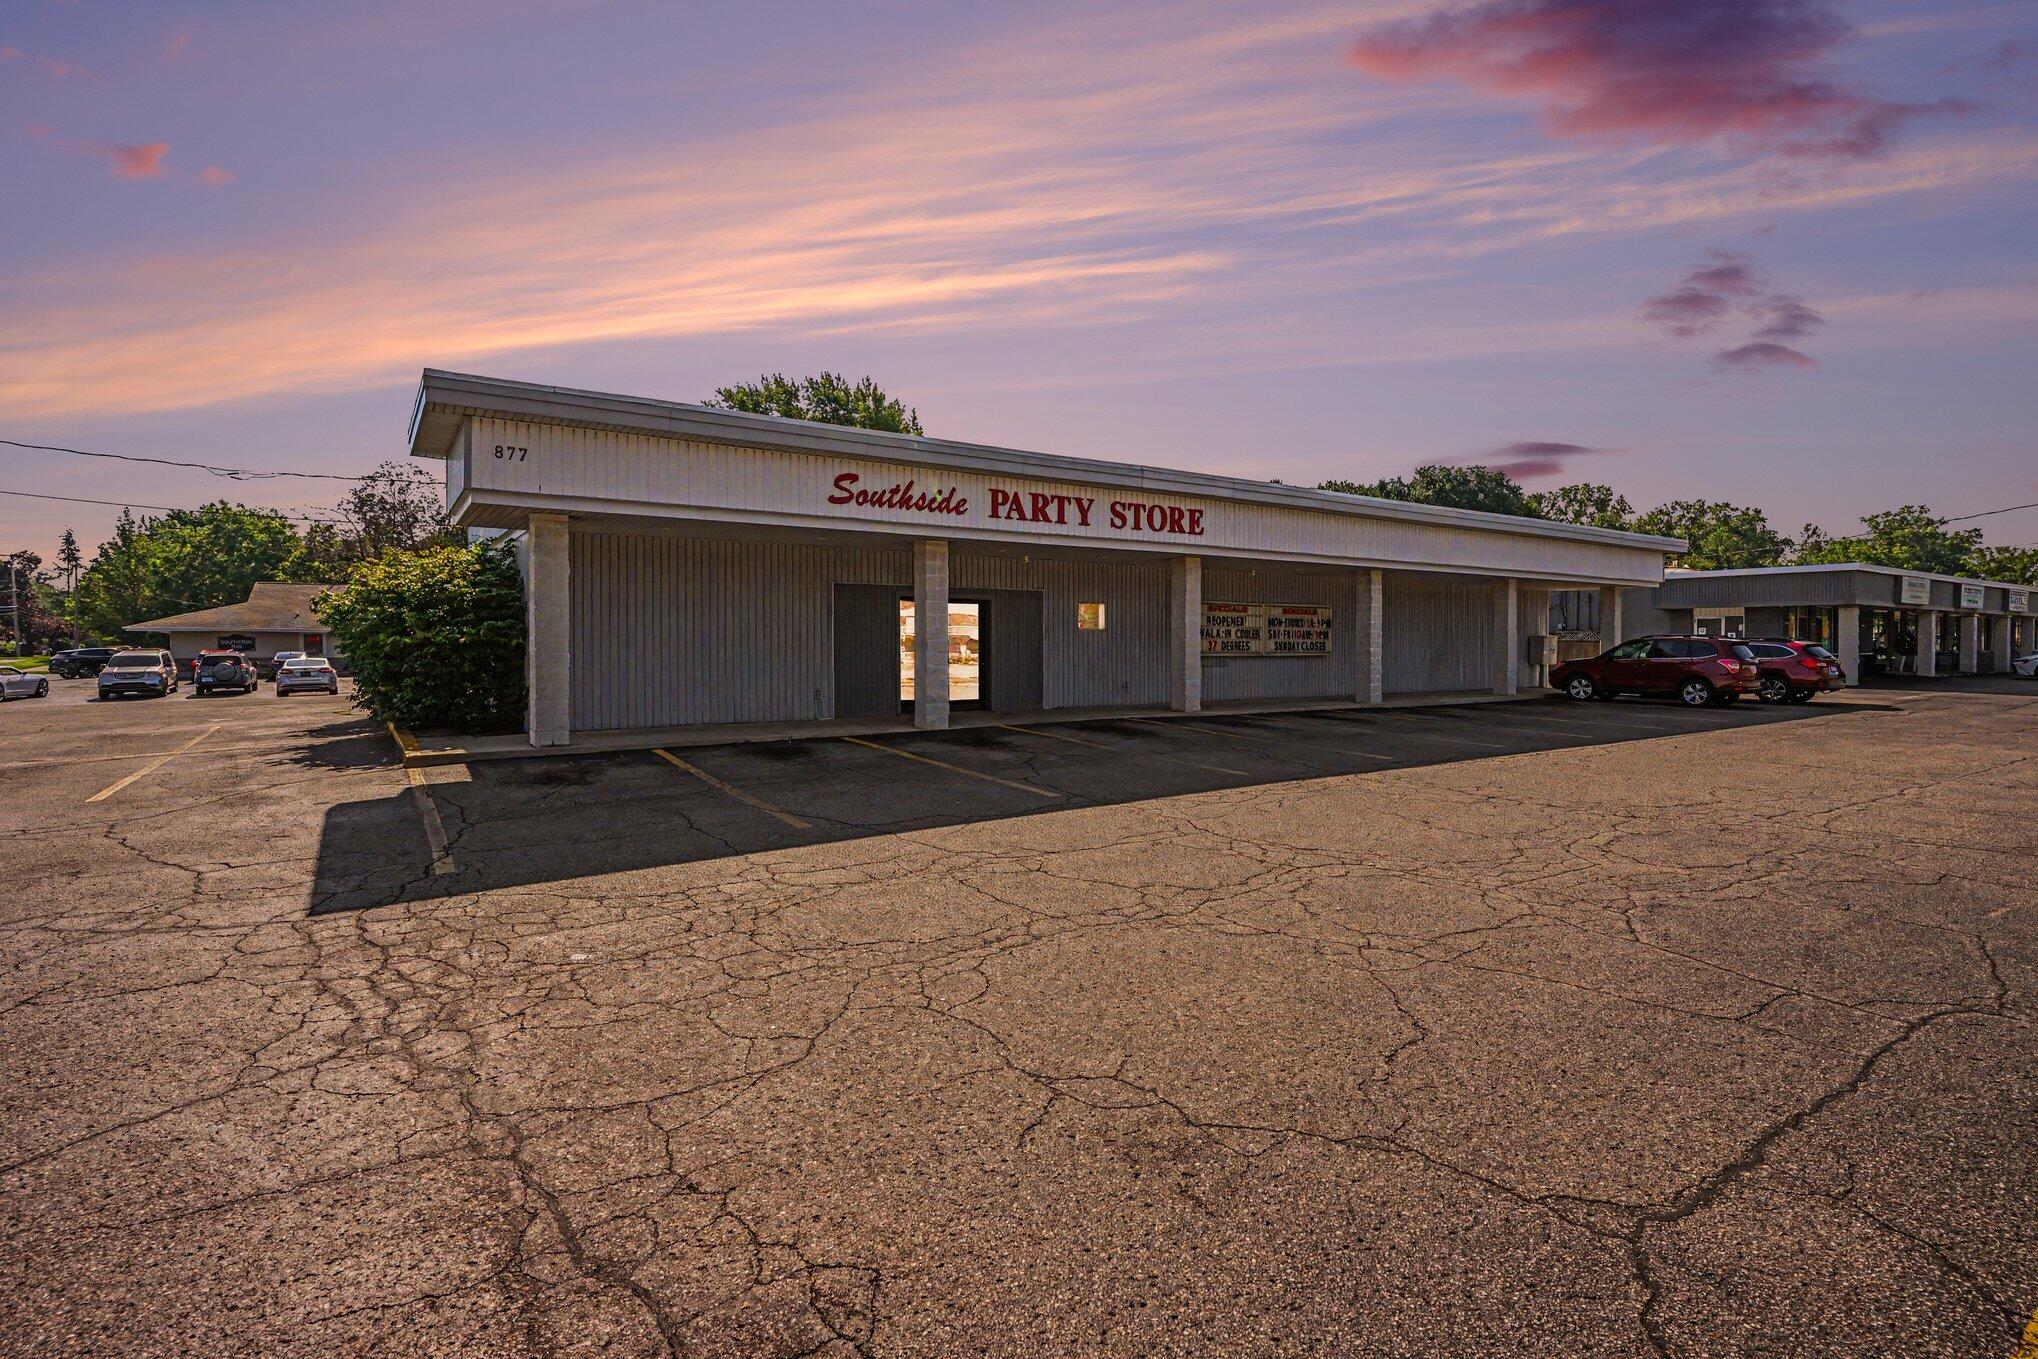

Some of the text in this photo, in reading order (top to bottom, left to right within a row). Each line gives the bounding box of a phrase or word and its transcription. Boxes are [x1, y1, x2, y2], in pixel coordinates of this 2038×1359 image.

[494, 445, 528, 462] 877
[828, 472, 1205, 536] Southside PARTY STORE
[1207, 604, 1248, 613] SPECIALS
[1208, 640, 1250, 651] 37 DEGREES
[1274, 641, 1327, 651] SUNDAY CLOSED
